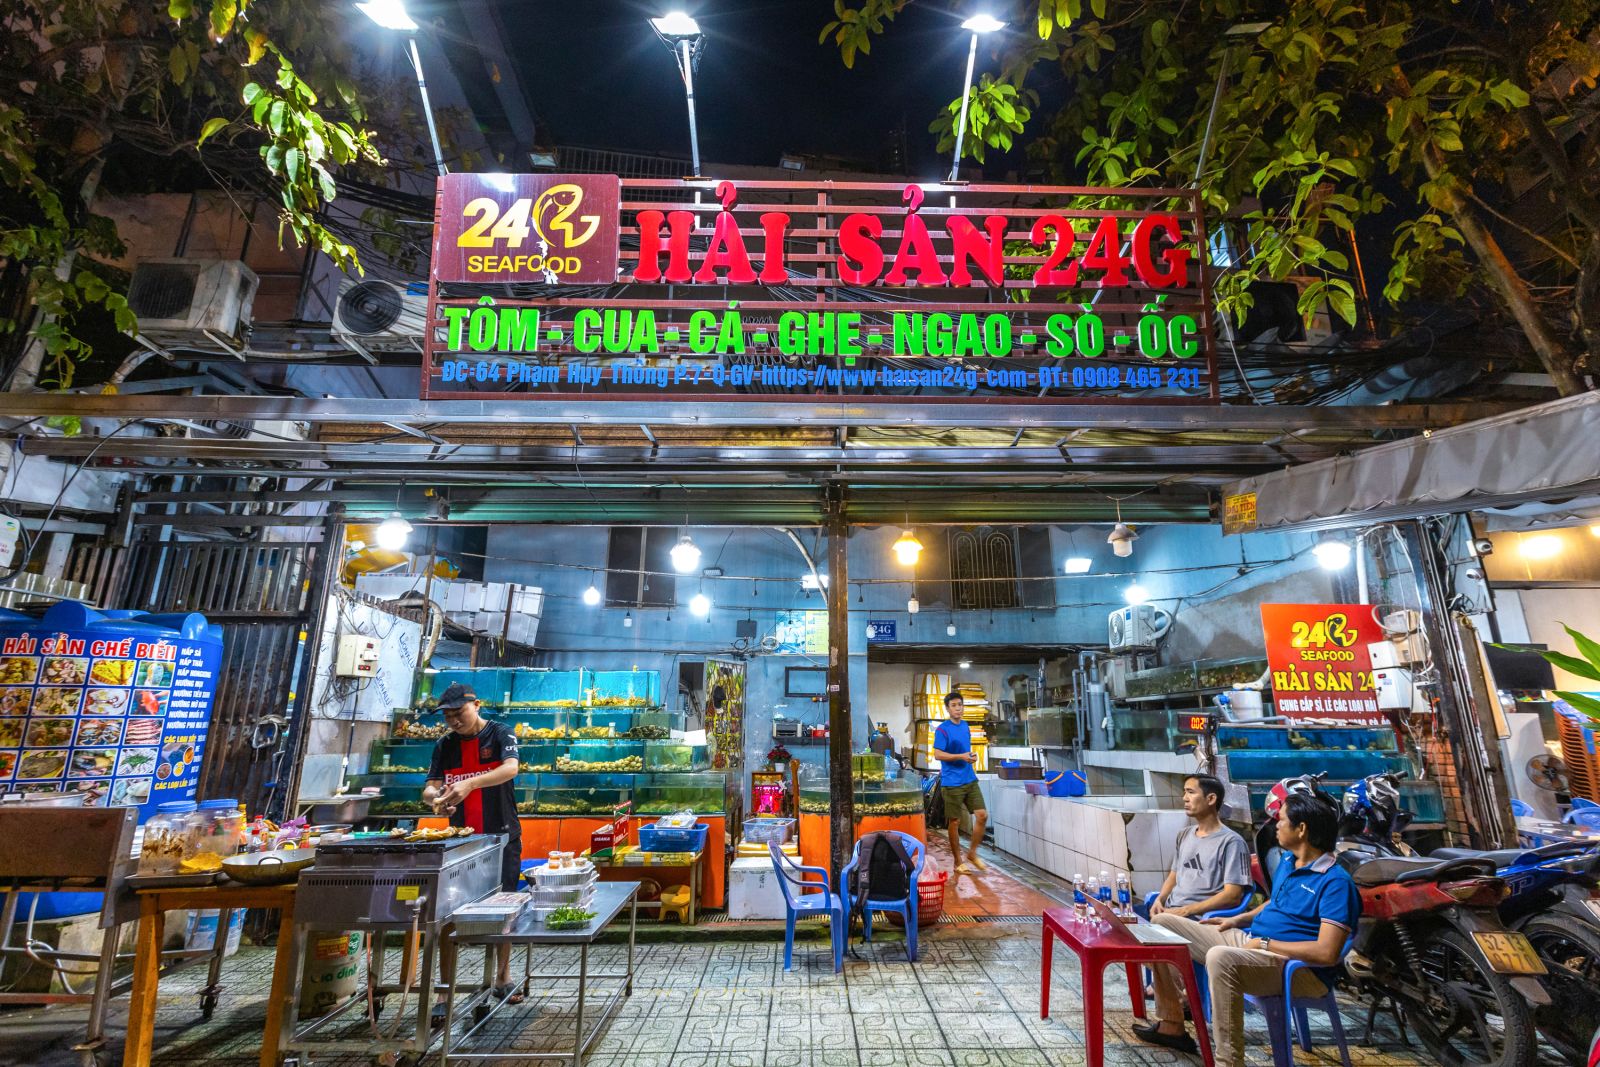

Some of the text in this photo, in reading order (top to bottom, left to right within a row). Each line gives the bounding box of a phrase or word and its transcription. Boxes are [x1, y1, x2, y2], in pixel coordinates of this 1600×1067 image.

[633, 181, 1191, 288] HẢI SẢN 24G
[467, 255, 582, 274] SEAFOOD
[444, 296, 540, 352] TÔM
[573, 308, 659, 353] CUA
[688, 301, 746, 354] CÁ
[778, 311, 863, 366] GHẸ
[893, 312, 1013, 357] NGAO
[1045, 302, 1105, 358] SÒ
[1138, 294, 1199, 359] ỐC
[507, 362, 560, 387] Phạm
[568, 363, 603, 387] Huy
[1072, 367, 1120, 388] 0908
[1126, 367, 1160, 388] 465
[1167, 367, 1199, 389] 231
[3, 632, 38, 655] HẢI
[40, 633, 86, 657] SẢN
[90, 637, 135, 658] CHẾ
[1300, 650, 1356, 661] SEAFOOD
[1272, 663, 1313, 692] HẢI
[1313, 664, 1355, 692] SẢN
[1279, 698, 1300, 712] CUNG
